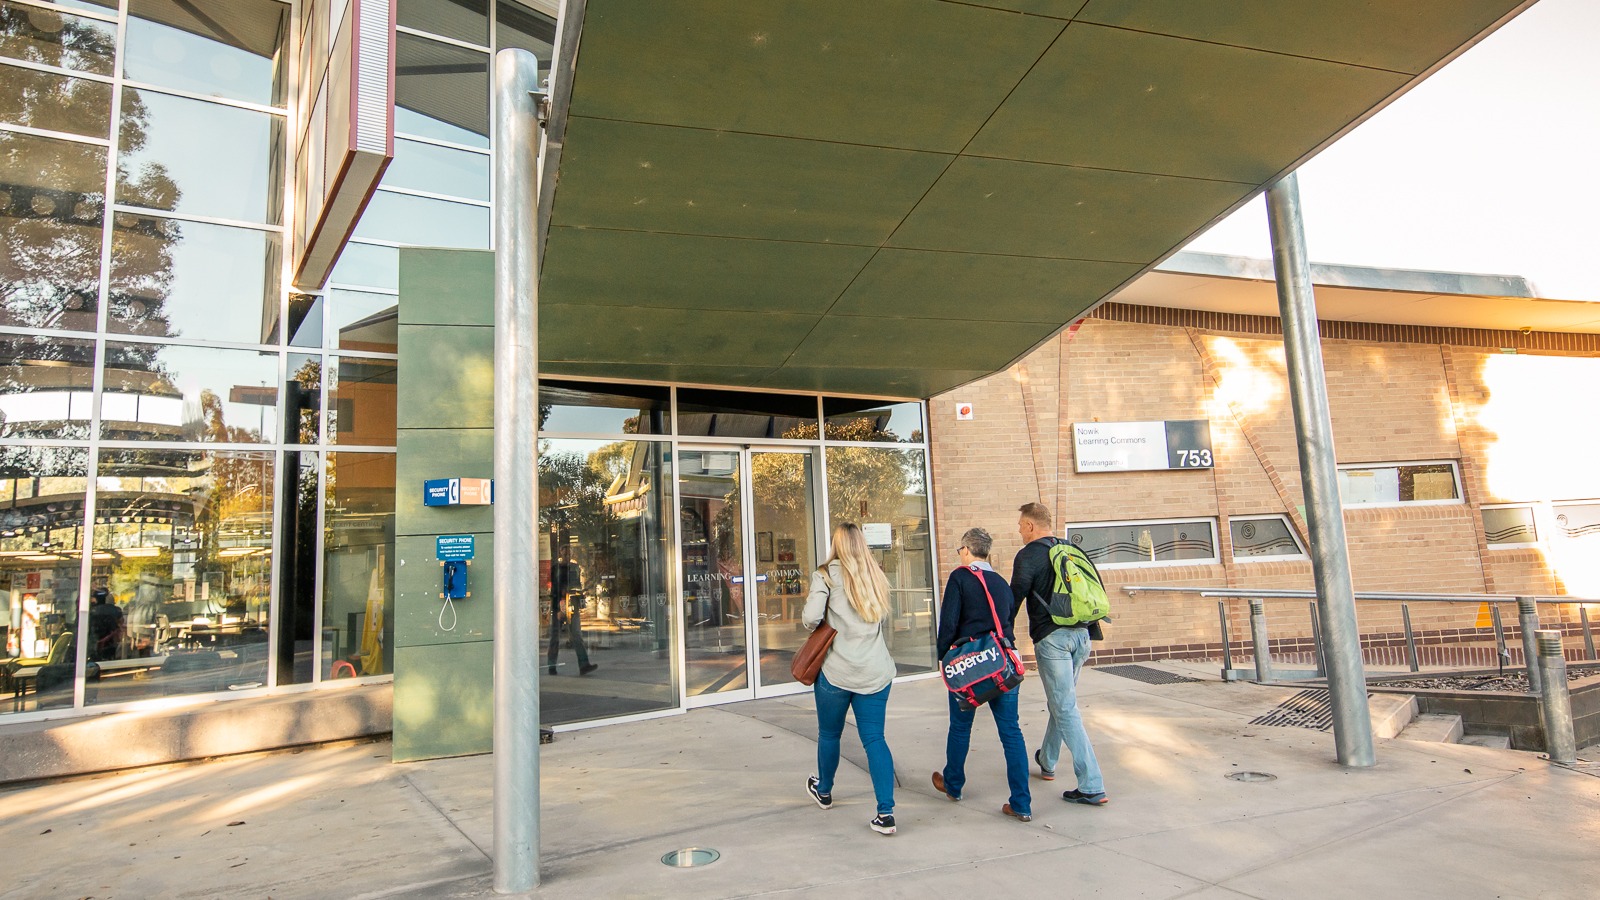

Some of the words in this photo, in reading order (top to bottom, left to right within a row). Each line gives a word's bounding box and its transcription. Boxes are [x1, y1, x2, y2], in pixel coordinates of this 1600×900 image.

[1078, 437, 1109, 446] Learning
[1110, 436, 1146, 445] Commons
[1176, 449, 1213, 467] 753
[687, 572, 732, 583] LEARNING
[765, 568, 804, 579] COMMONS
